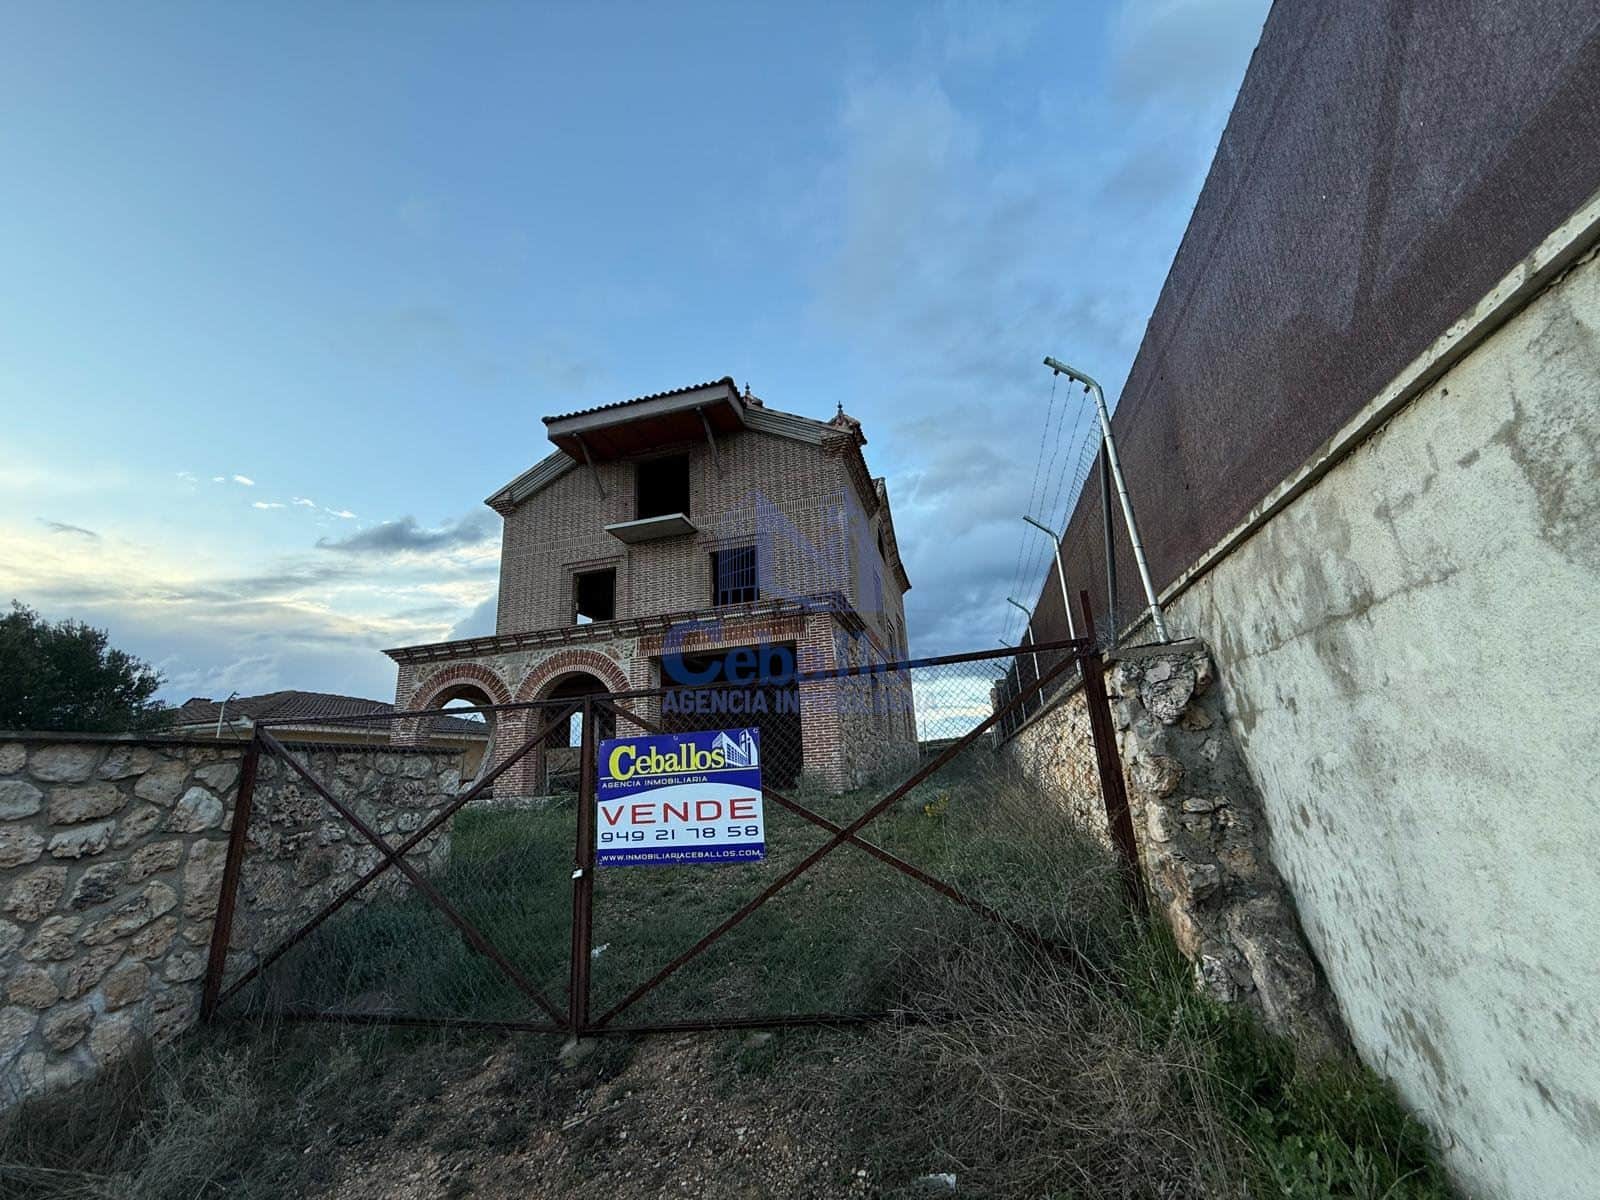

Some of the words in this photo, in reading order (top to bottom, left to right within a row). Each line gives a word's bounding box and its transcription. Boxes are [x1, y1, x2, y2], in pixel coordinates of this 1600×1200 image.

[608, 742, 725, 781] Ceballos
[601, 780, 641, 789] AGENCIA
[644, 775, 709, 786] INMOBILIARIA
[600, 797, 758, 826] VENDE
[600, 830, 645, 843] 949
[655, 829, 675, 841] 21
[686, 827, 716, 839] 78
[727, 825, 759, 838] 58
[601, 849, 761, 862] WWW.INMOBILIARIACEBALLOS.COM
